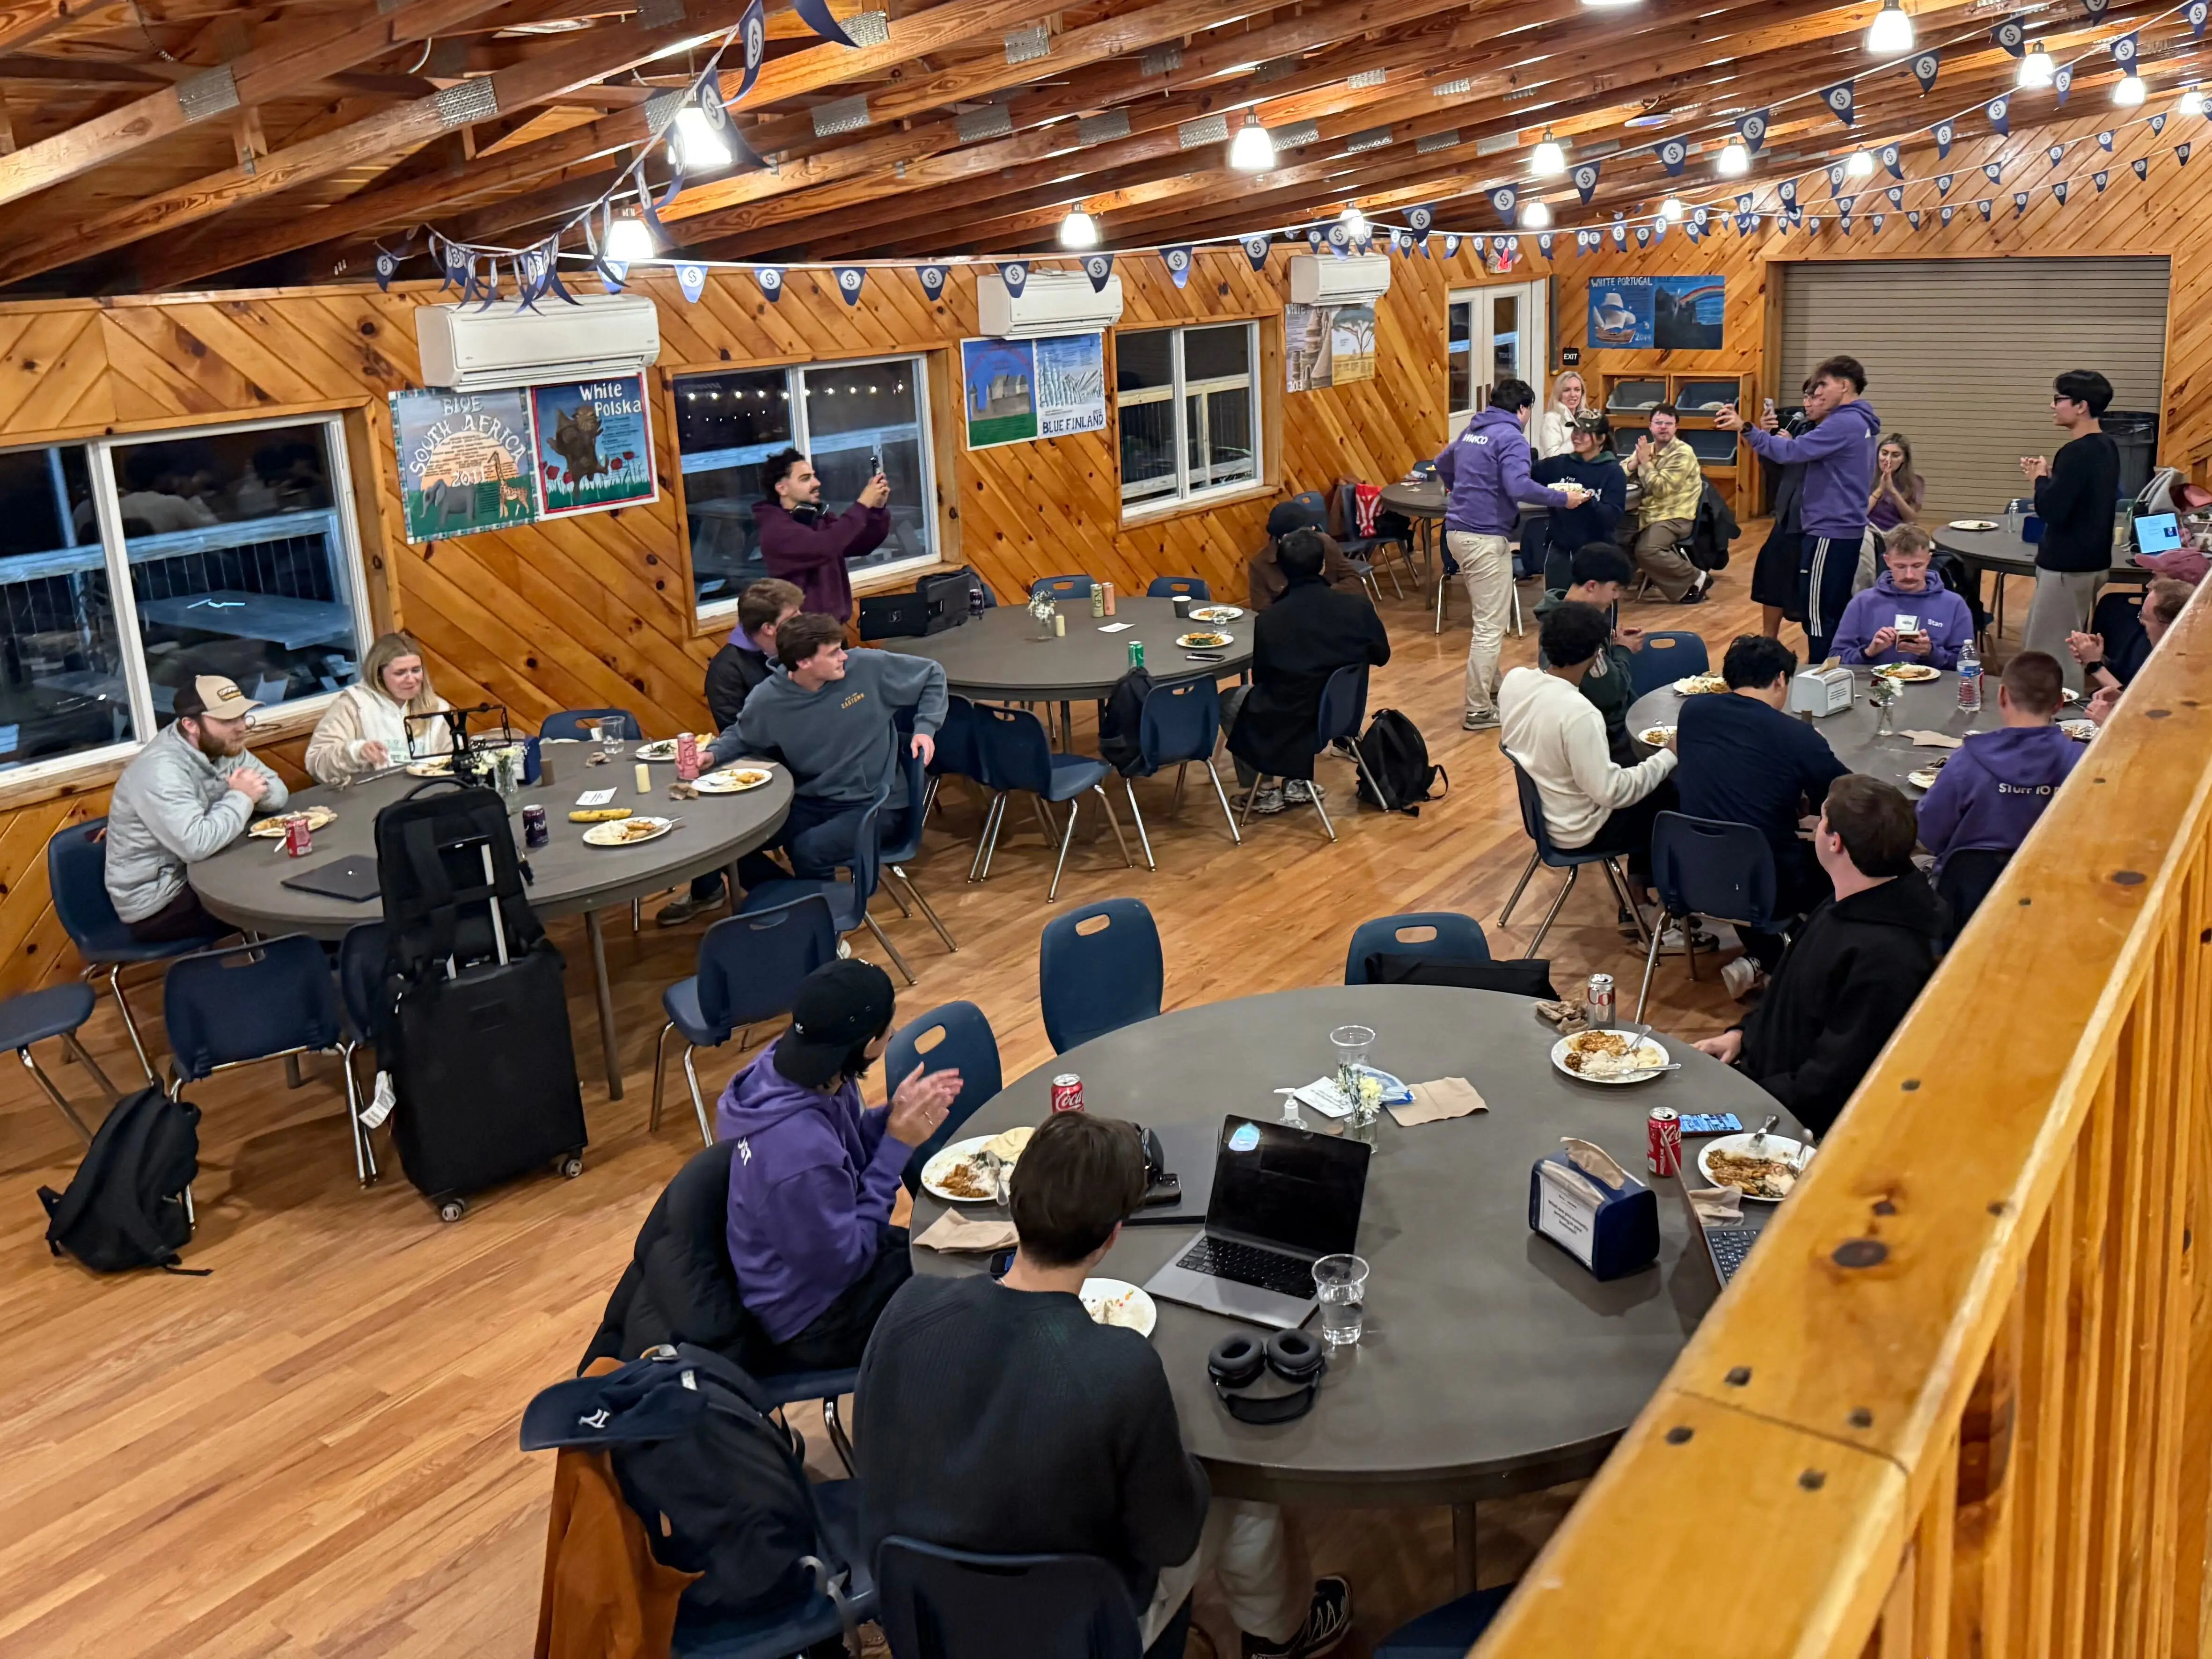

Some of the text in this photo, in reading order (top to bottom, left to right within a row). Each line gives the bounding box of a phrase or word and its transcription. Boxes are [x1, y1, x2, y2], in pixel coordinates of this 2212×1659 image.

[1591, 277, 1653, 287] WHITE PORTUGAL
[579, 382, 623, 401] White
[443, 395, 483, 416] BLUE
[594, 399, 642, 417] Polska
[1042, 414, 1104, 434] BLUE FINLAND
[409, 420, 452, 477] SOUTH
[461, 414, 527, 464] AFRICA
